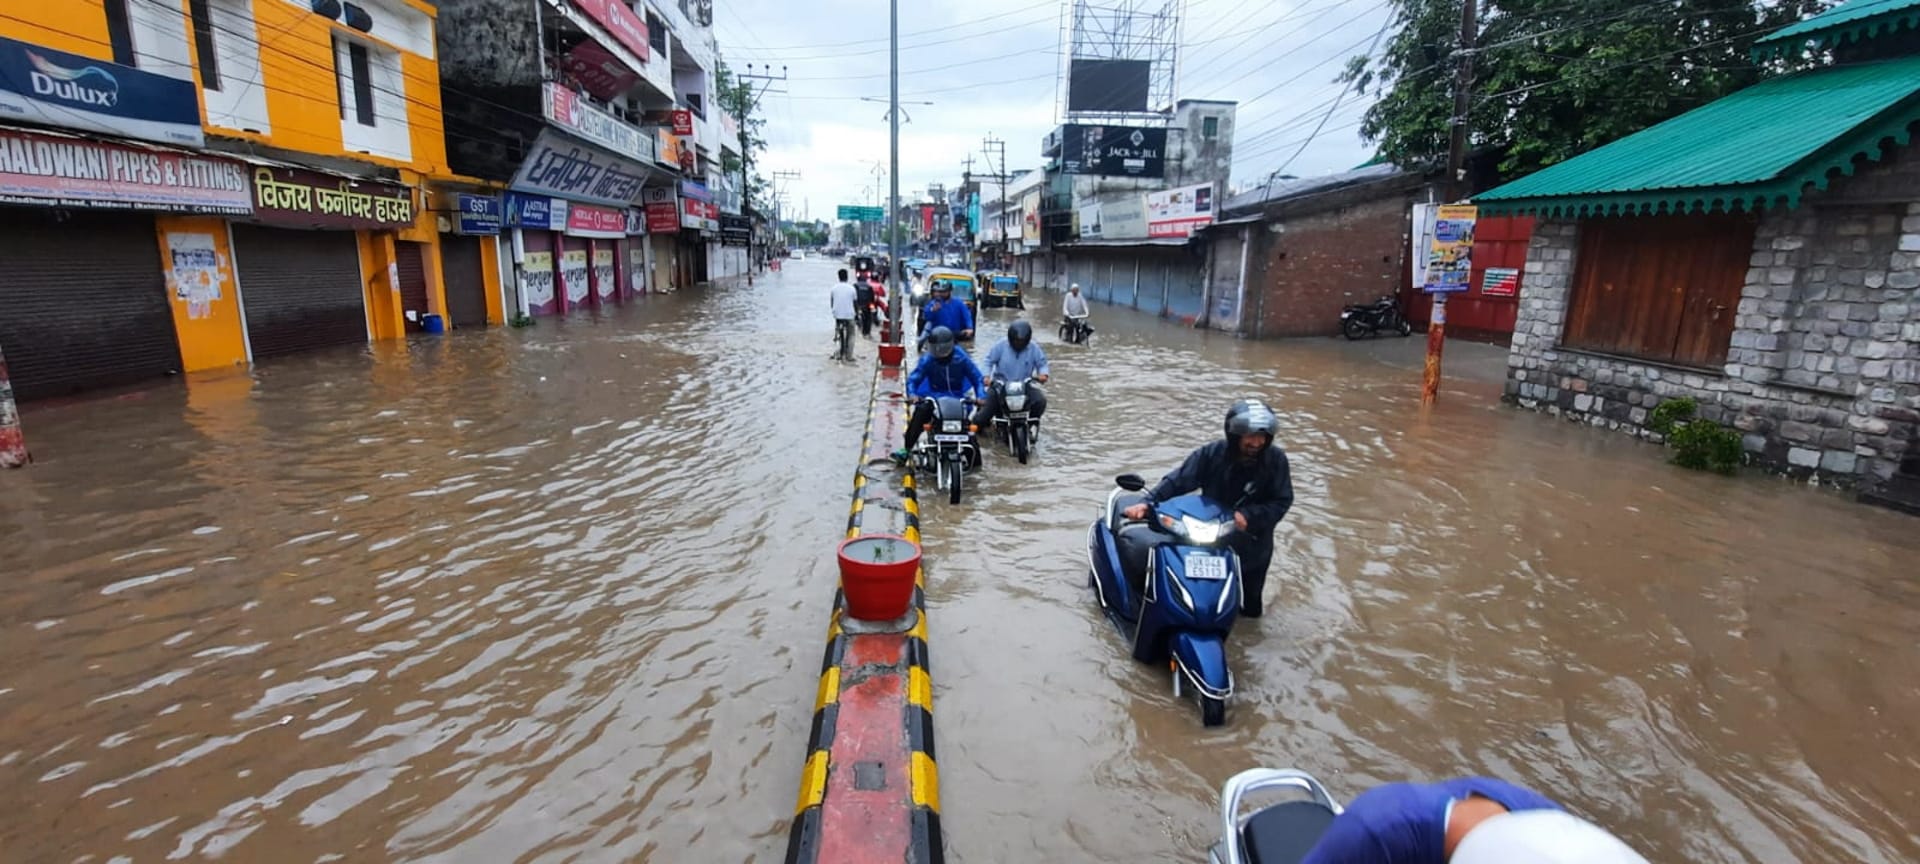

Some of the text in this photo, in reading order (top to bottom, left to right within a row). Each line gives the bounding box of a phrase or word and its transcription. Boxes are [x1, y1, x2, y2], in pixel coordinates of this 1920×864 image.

[30, 71, 113, 107] Dulux
[0, 137, 244, 192] HALDWANI PIPES & FITTINGS
[1107, 146, 1131, 158] JACK
[1140, 148, 1158, 159] JILL
[255, 168, 312, 212] विजय
[374, 195, 412, 223] हाउस
[470, 199, 489, 213] GST
[566, 267, 587, 289] erger
